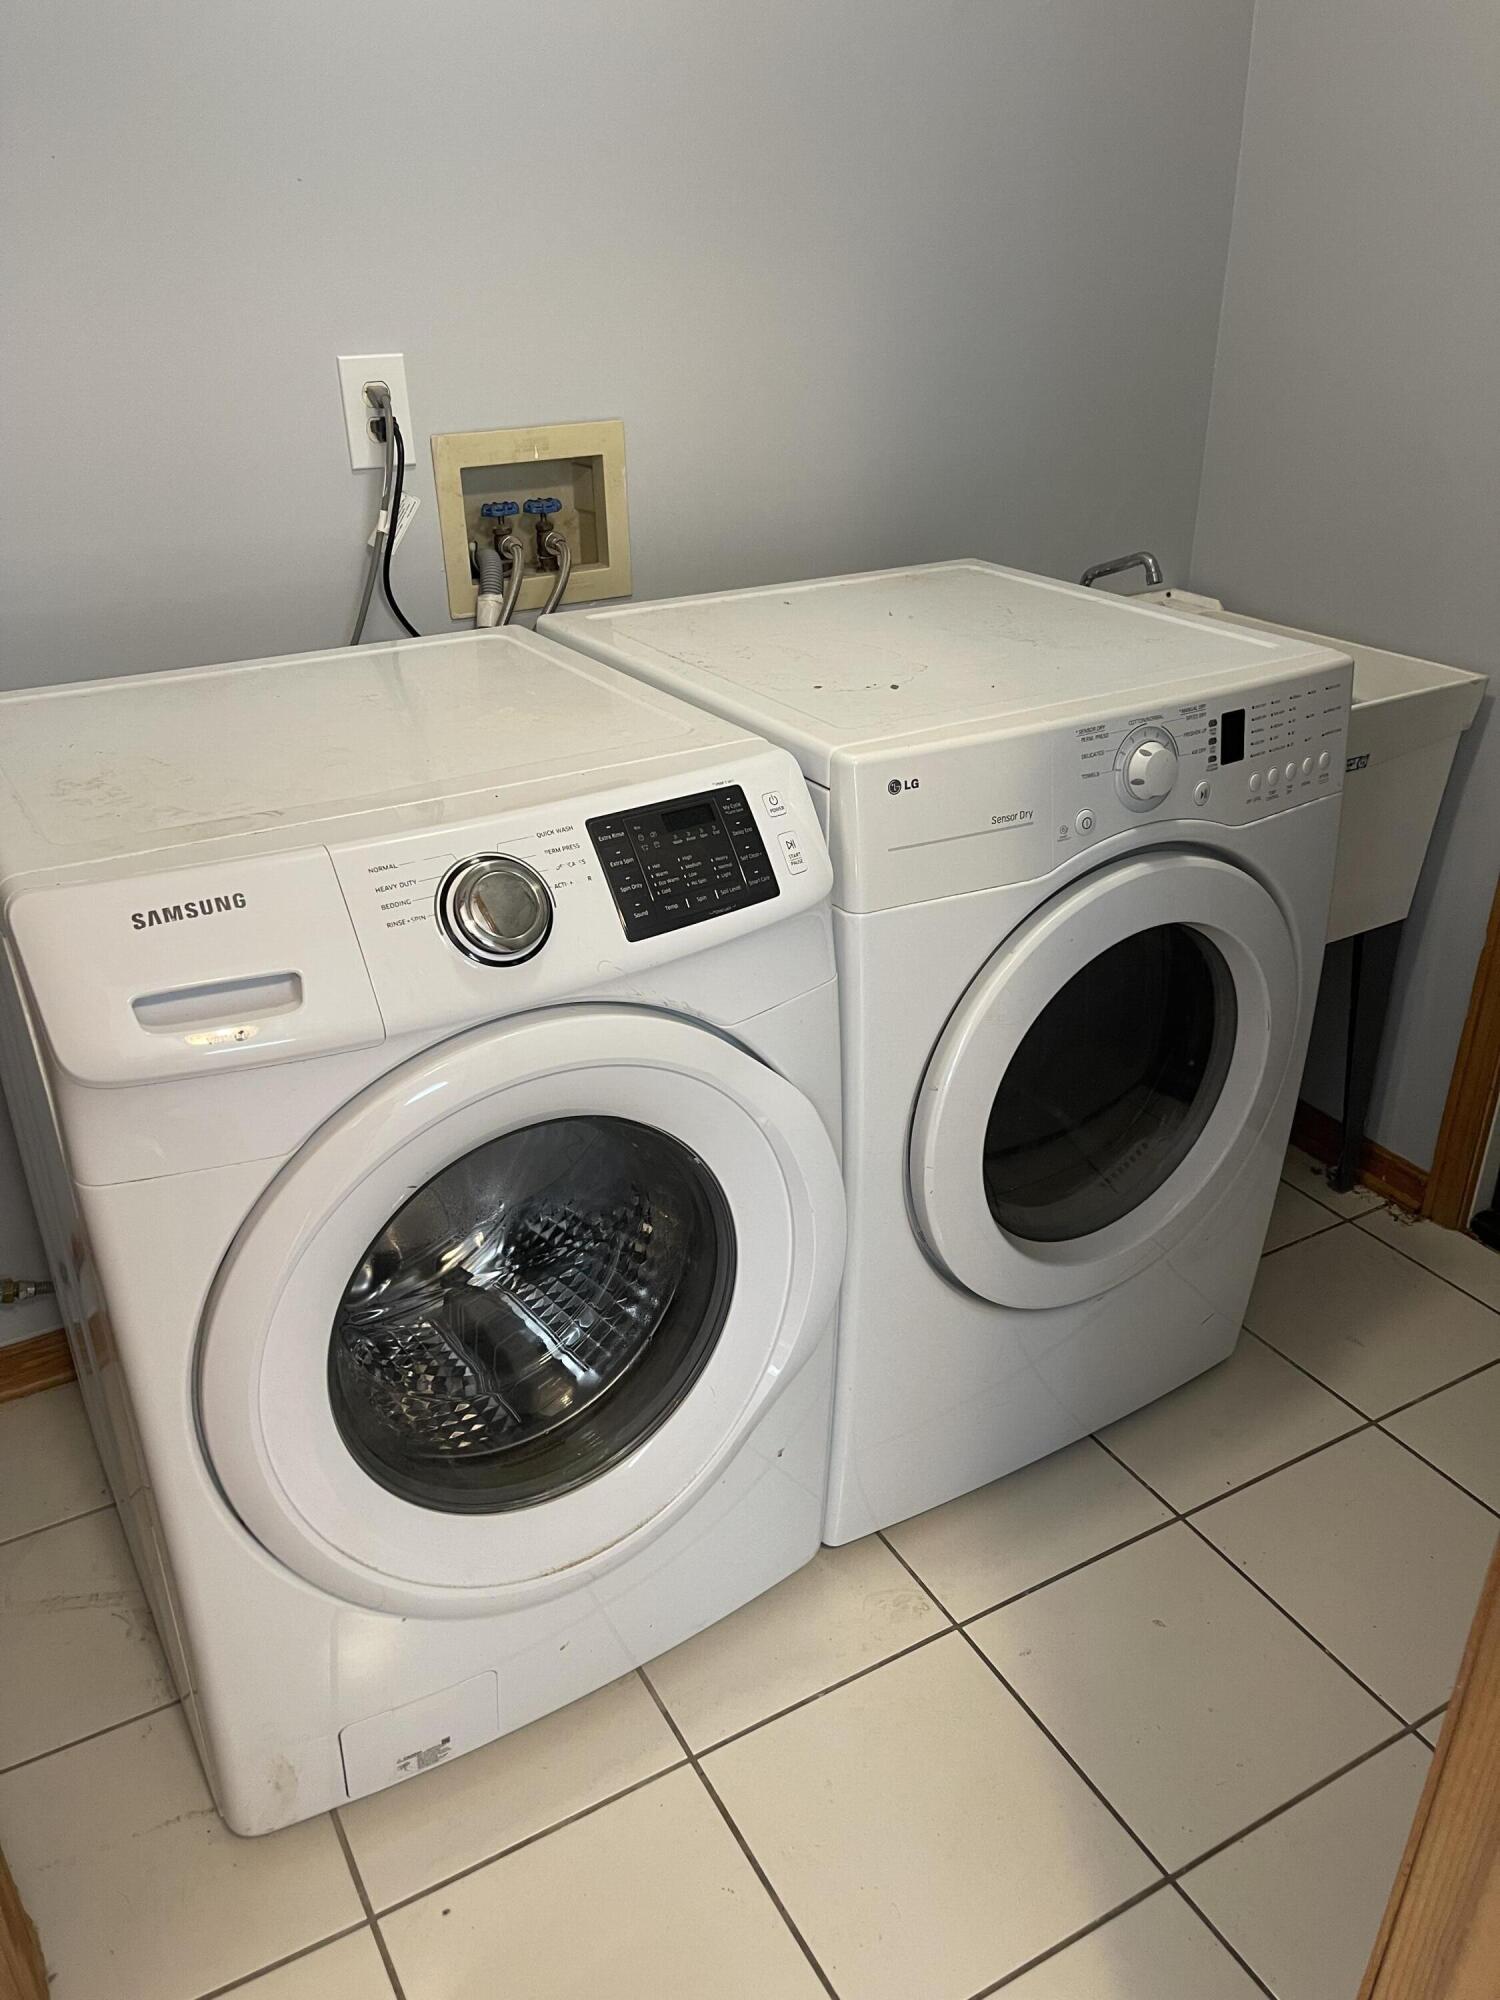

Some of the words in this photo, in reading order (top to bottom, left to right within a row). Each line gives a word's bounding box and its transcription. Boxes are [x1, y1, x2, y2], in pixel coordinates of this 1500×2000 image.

[770, 805, 785, 813] POWER
[991, 812, 1018, 825] Sensor
[1019, 809, 1034, 821] Dry
[536, 829, 555, 839] QUICK
[556, 825, 574, 834] WASH
[598, 834, 611, 842] Extra
[562, 842, 581, 852] PRESS
[788, 851, 801, 860] START
[609, 860, 623, 868] Extra
[623, 857, 634, 865] Spin
[368, 863, 399, 874] NORMAL
[375, 883, 397, 893] HEAVY
[399, 879, 417, 888] DUTY
[631, 883, 643, 891] Only
[381, 899, 412, 911] BEDDING
[664, 903, 679, 911] Temp
[131, 892, 247, 930] SAMSUNG
[633, 910, 649, 919] Sound
